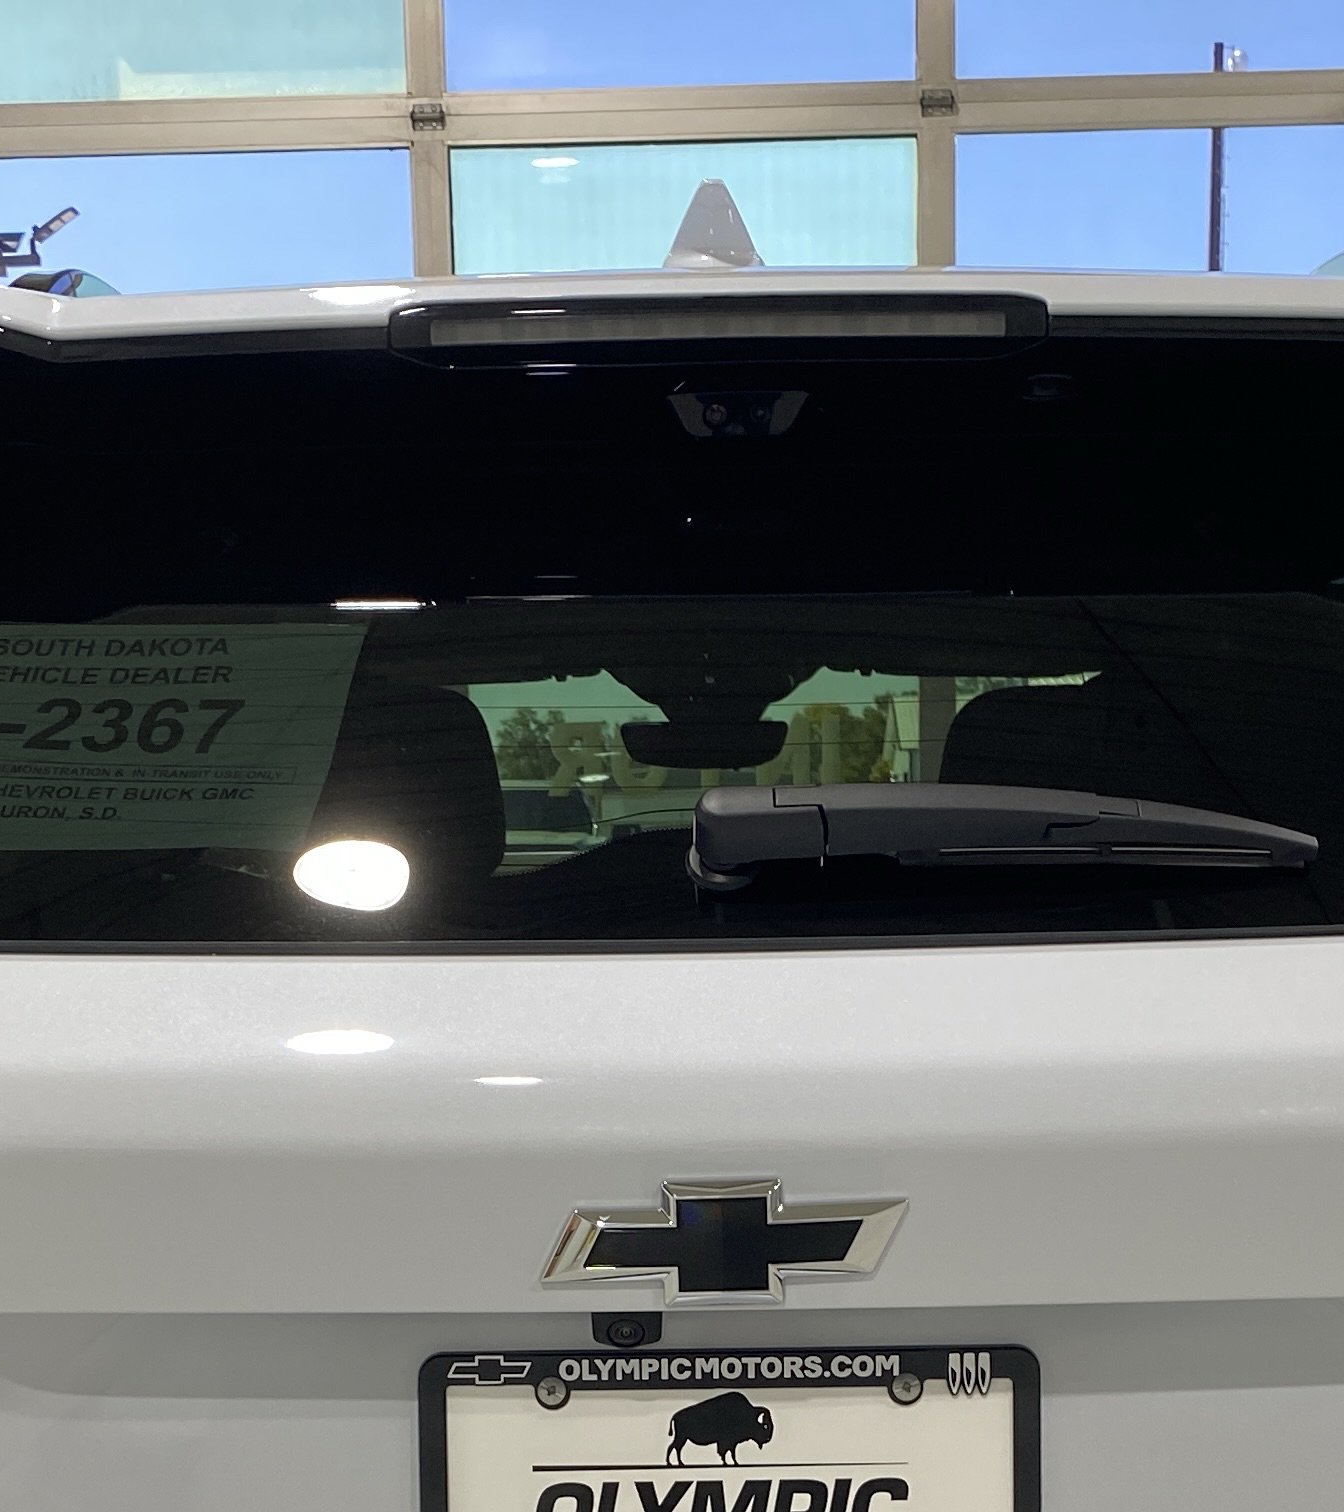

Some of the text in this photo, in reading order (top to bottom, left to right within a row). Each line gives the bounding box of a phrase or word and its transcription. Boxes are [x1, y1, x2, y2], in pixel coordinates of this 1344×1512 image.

[104, 637, 229, 657] DAKOTA
[109, 665, 233, 685] DEALER
[214, 769, 244, 779] USE
[246, 769, 284, 781] ONLY
[122, 787, 196, 801] BUICK
[201, 787, 256, 801] GMC
[558, 1354, 900, 1381] OLYMPICMOTORS.COM
